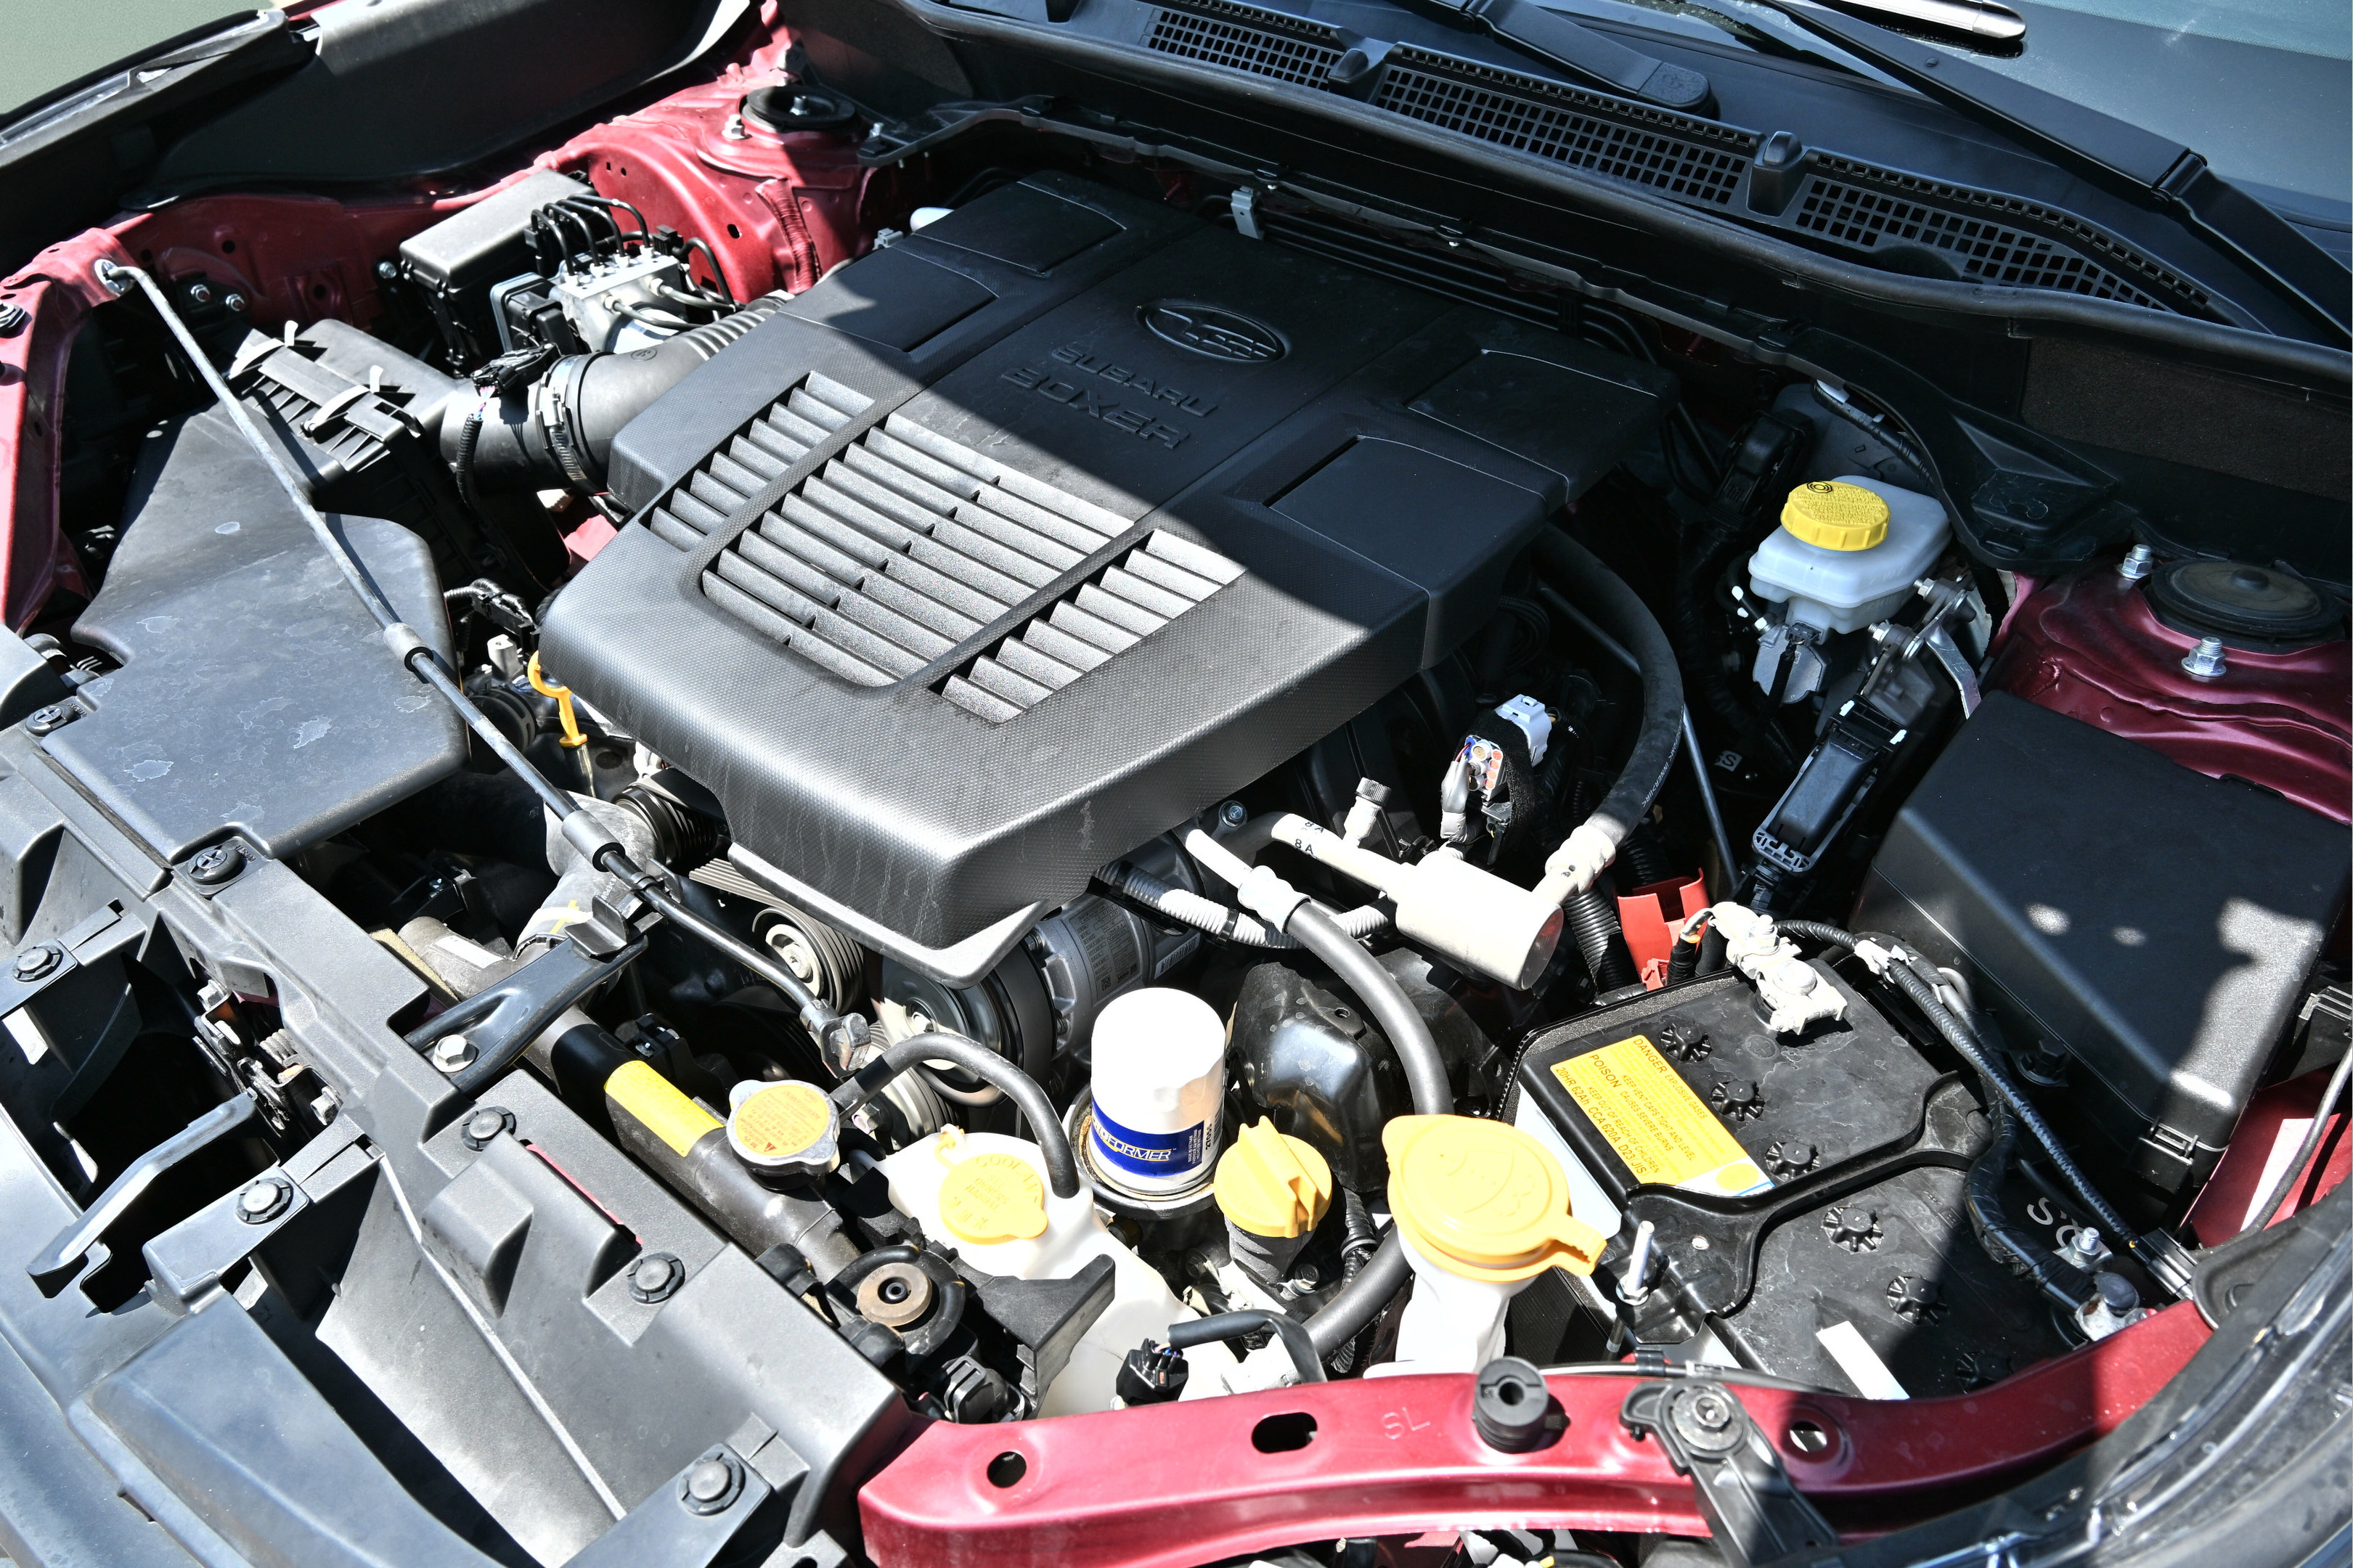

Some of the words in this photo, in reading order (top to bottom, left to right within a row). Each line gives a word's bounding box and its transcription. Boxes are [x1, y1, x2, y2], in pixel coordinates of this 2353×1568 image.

[1001, 367, 1190, 449] BOXER
[1051, 343, 1218, 417] SUBARU
[1554, 1066, 1578, 1087] 20HR
[1570, 1086, 1592, 1105] 62Ah
[1586, 1106, 1607, 1124] CCA
[1599, 1122, 1623, 1143] 620A
[1587, 1053, 1622, 1088] POISON
[1618, 1090, 1642, 1112] CAUSES
[1636, 1111, 1658, 1132] SEVERE
[1652, 1131, 1674, 1151] BURNS
[1631, 1038, 1668, 1073] DANGER
[1663, 1074, 1693, 1102] EXPLOSIVE
[1687, 1101, 1708, 1119] GASES
[1093, 1118, 1171, 1159] ROFORMER
[1586, 1086, 1602, 1101] KEEP
[1596, 1099, 1611, 1111] OUT
[1605, 1111, 1618, 1119] OF
[1612, 1119, 1633, 1138] REACH
[1626, 1137, 1639, 1146] OF
[1633, 1145, 1661, 1174] CHILDREN
[1620, 1074, 1637, 1089] KEEP
[1631, 1087, 1648, 1102] VENT
[1642, 1101, 1660, 1116] CAPS
[1655, 1115, 1673, 1132] TIGHT
[1667, 1130, 1684, 1143] AND
[1677, 1142, 1698, 1161] LEVEL
[964, 1183, 1000, 1213] MANUAL
[975, 1155, 1038, 1204] COOLANT
[1380, 1406, 1431, 1440] SL
